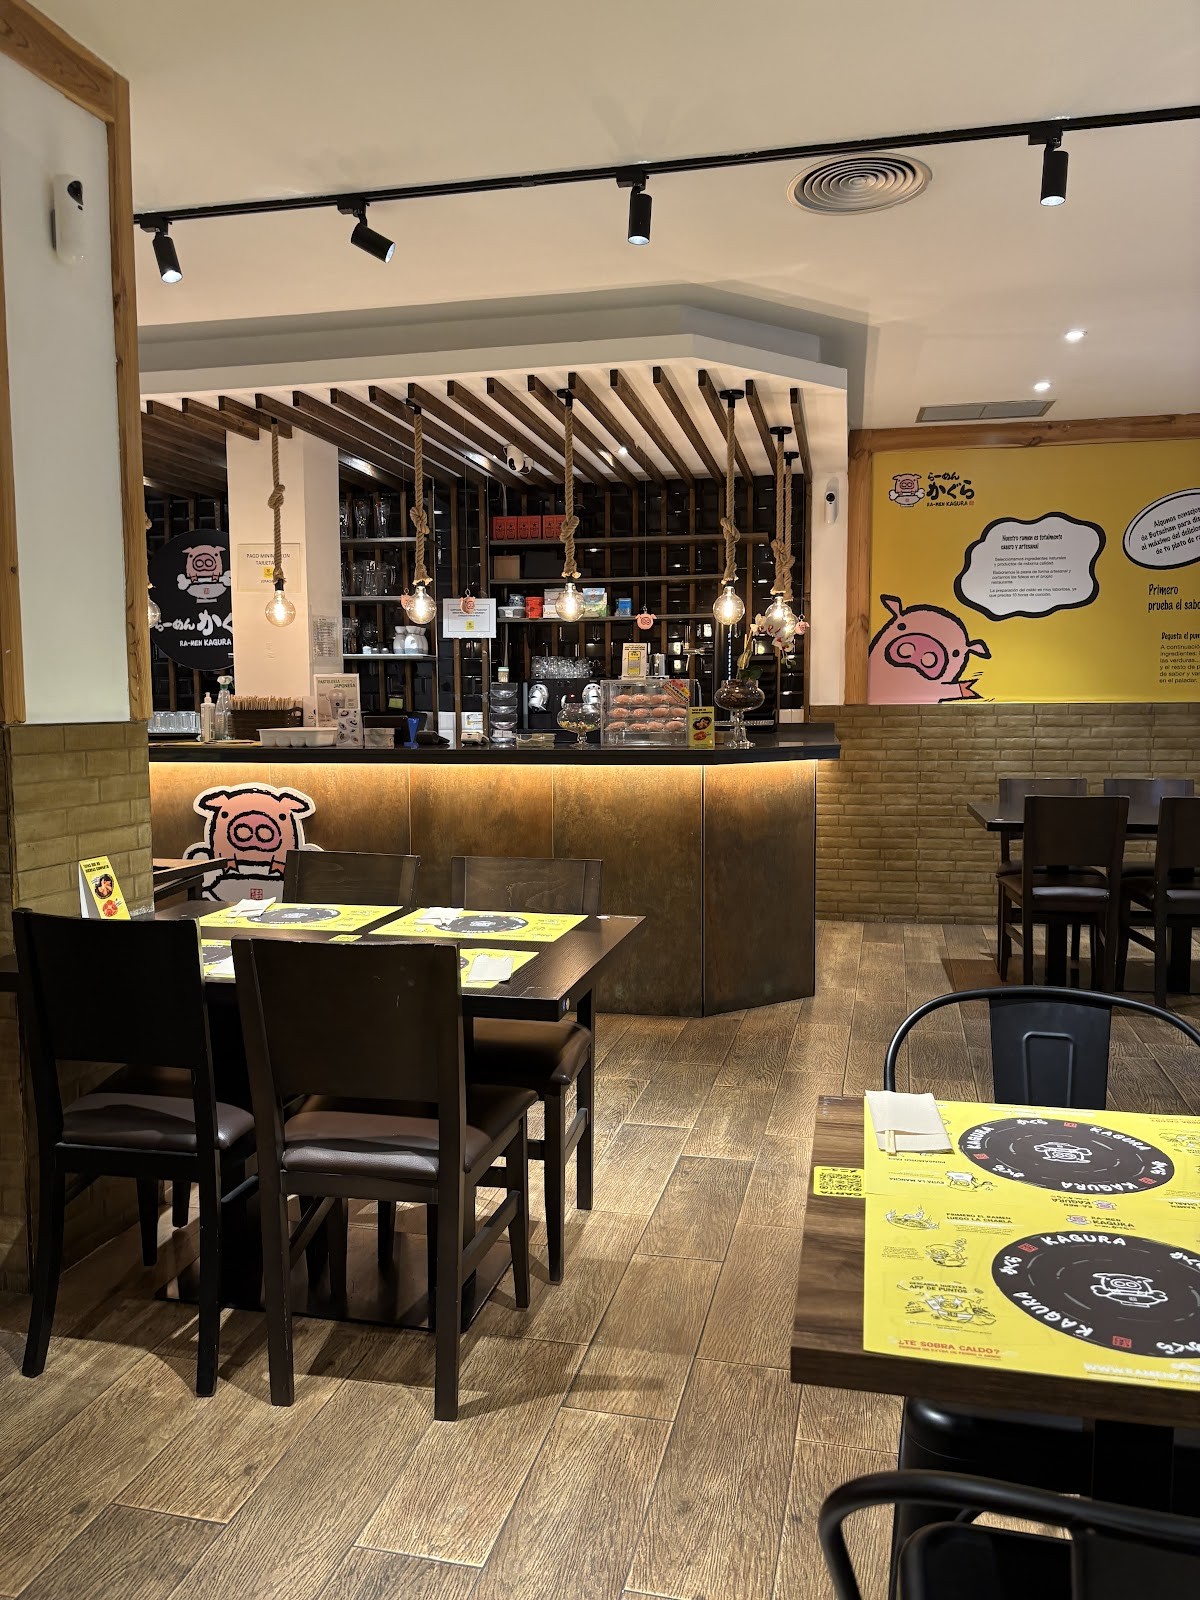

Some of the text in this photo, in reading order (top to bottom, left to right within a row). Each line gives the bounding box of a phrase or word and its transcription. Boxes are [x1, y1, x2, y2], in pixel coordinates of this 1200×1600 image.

[927, 472, 960, 482] らーめん
[926, 480, 975, 500] かぐら
[1154, 516, 1176, 528] Algunos
[1177, 520, 1191, 530] para
[1002, 534, 1018, 542] Nuestro
[1148, 536, 1171, 548] máximo
[1172, 531, 1180, 540] del
[1172, 540, 1187, 551] plato
[1148, 583, 1178, 596] Primero
[1148, 600, 1173, 613] prueba
[1176, 599, 1182, 610] el
[204, 638, 232, 646] KAGURA
[1161, 632, 1182, 641] Degusta
[1184, 632, 1188, 640] el
[967, 1126, 996, 1150] KAGURA
[1090, 1126, 1152, 1150] KAGURA
[1061, 1181, 1138, 1191] KAGURA
[1041, 1234, 1126, 1246] KAGURA
[1001, 1255, 1022, 1275] かぐら
[1013, 1292, 1094, 1336] KAGURA
[920, 1341, 955, 1350] SOBRA
[959, 1346, 1000, 1354] CALDO?
